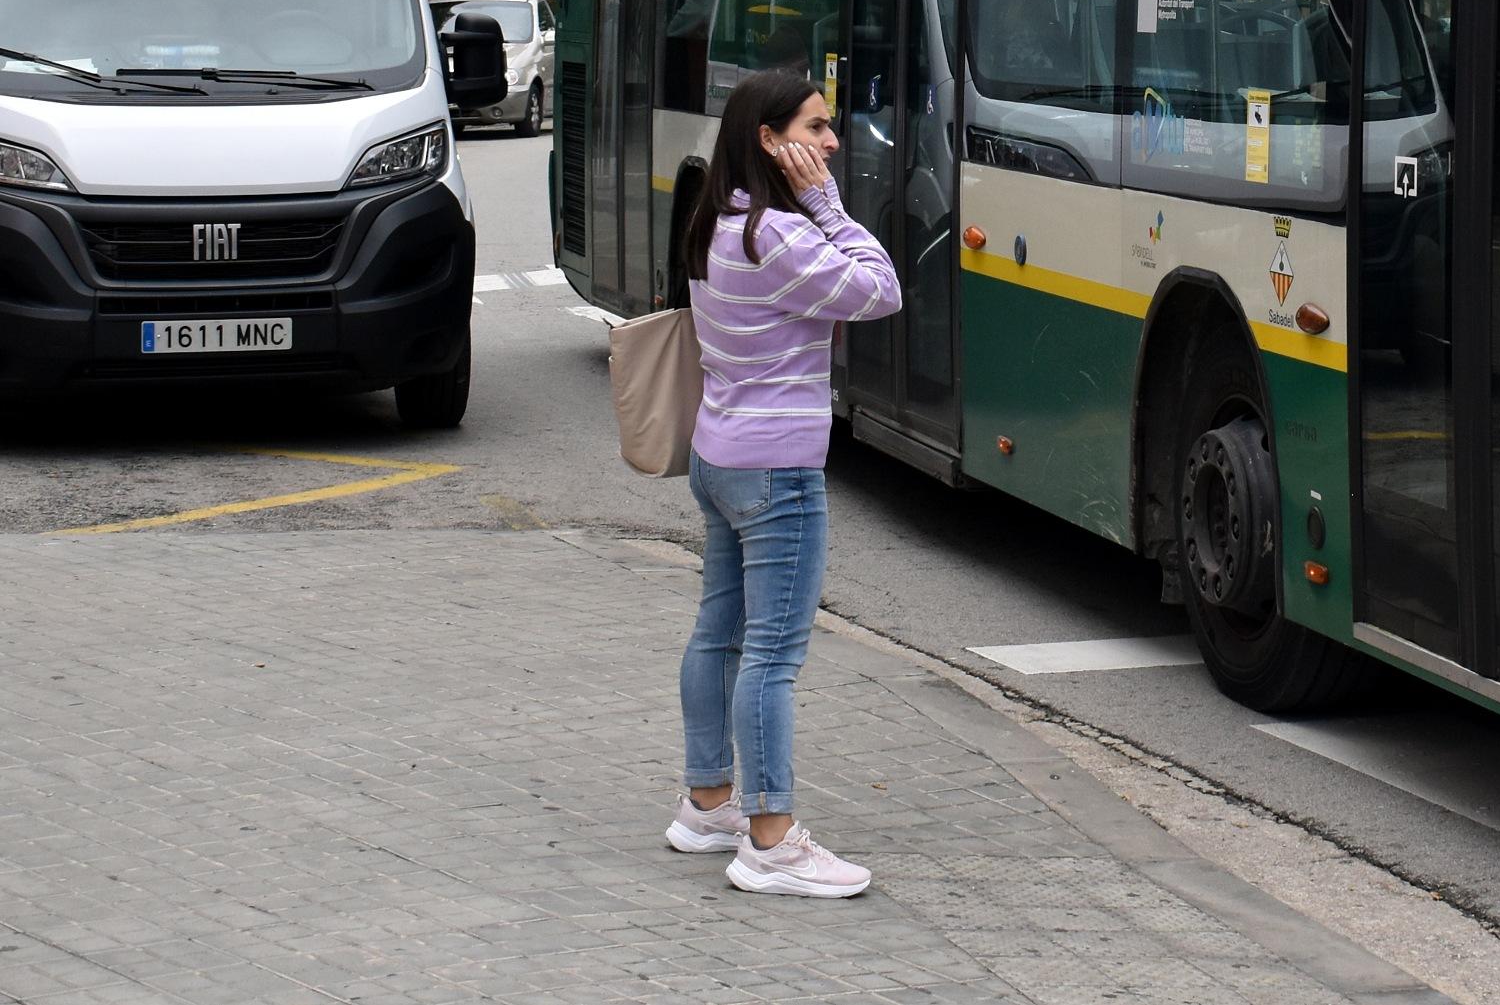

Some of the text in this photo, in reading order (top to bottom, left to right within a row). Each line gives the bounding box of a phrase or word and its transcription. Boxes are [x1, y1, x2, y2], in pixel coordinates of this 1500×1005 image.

[193, 223, 241, 261] FIAT
[1268, 308, 1295, 329] Sabadell
[164, 325, 223, 348] 1611
[236, 323, 285, 347] MNC
